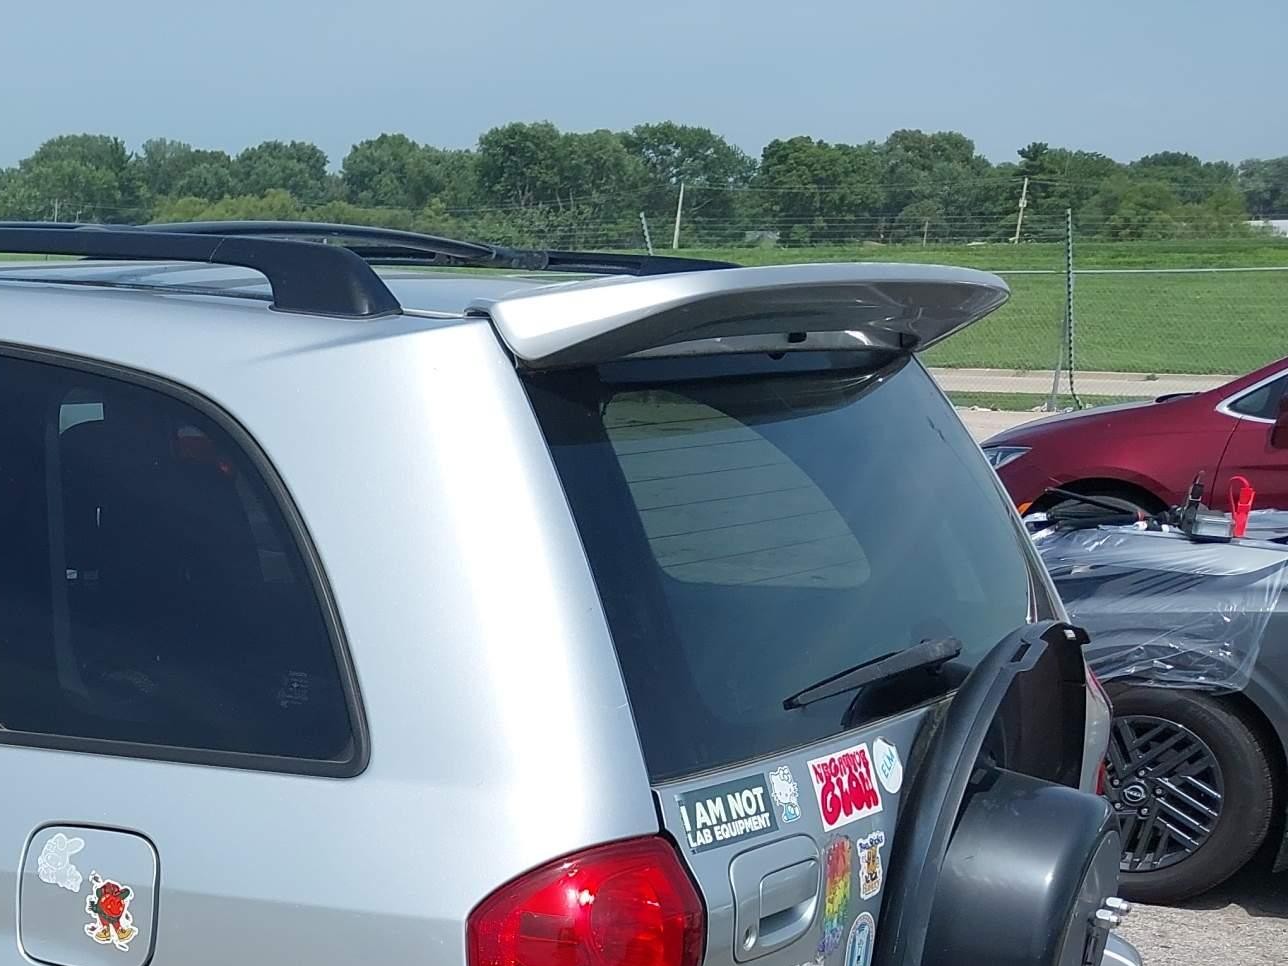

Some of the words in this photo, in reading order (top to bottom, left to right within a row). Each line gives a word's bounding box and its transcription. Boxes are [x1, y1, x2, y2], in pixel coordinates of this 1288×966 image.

[680, 805, 691, 831] I
[696, 798, 726, 826] AM
[730, 786, 765, 819] NOT
[687, 829, 713, 848] LAB
[715, 812, 771, 840] EQUIPMENT
